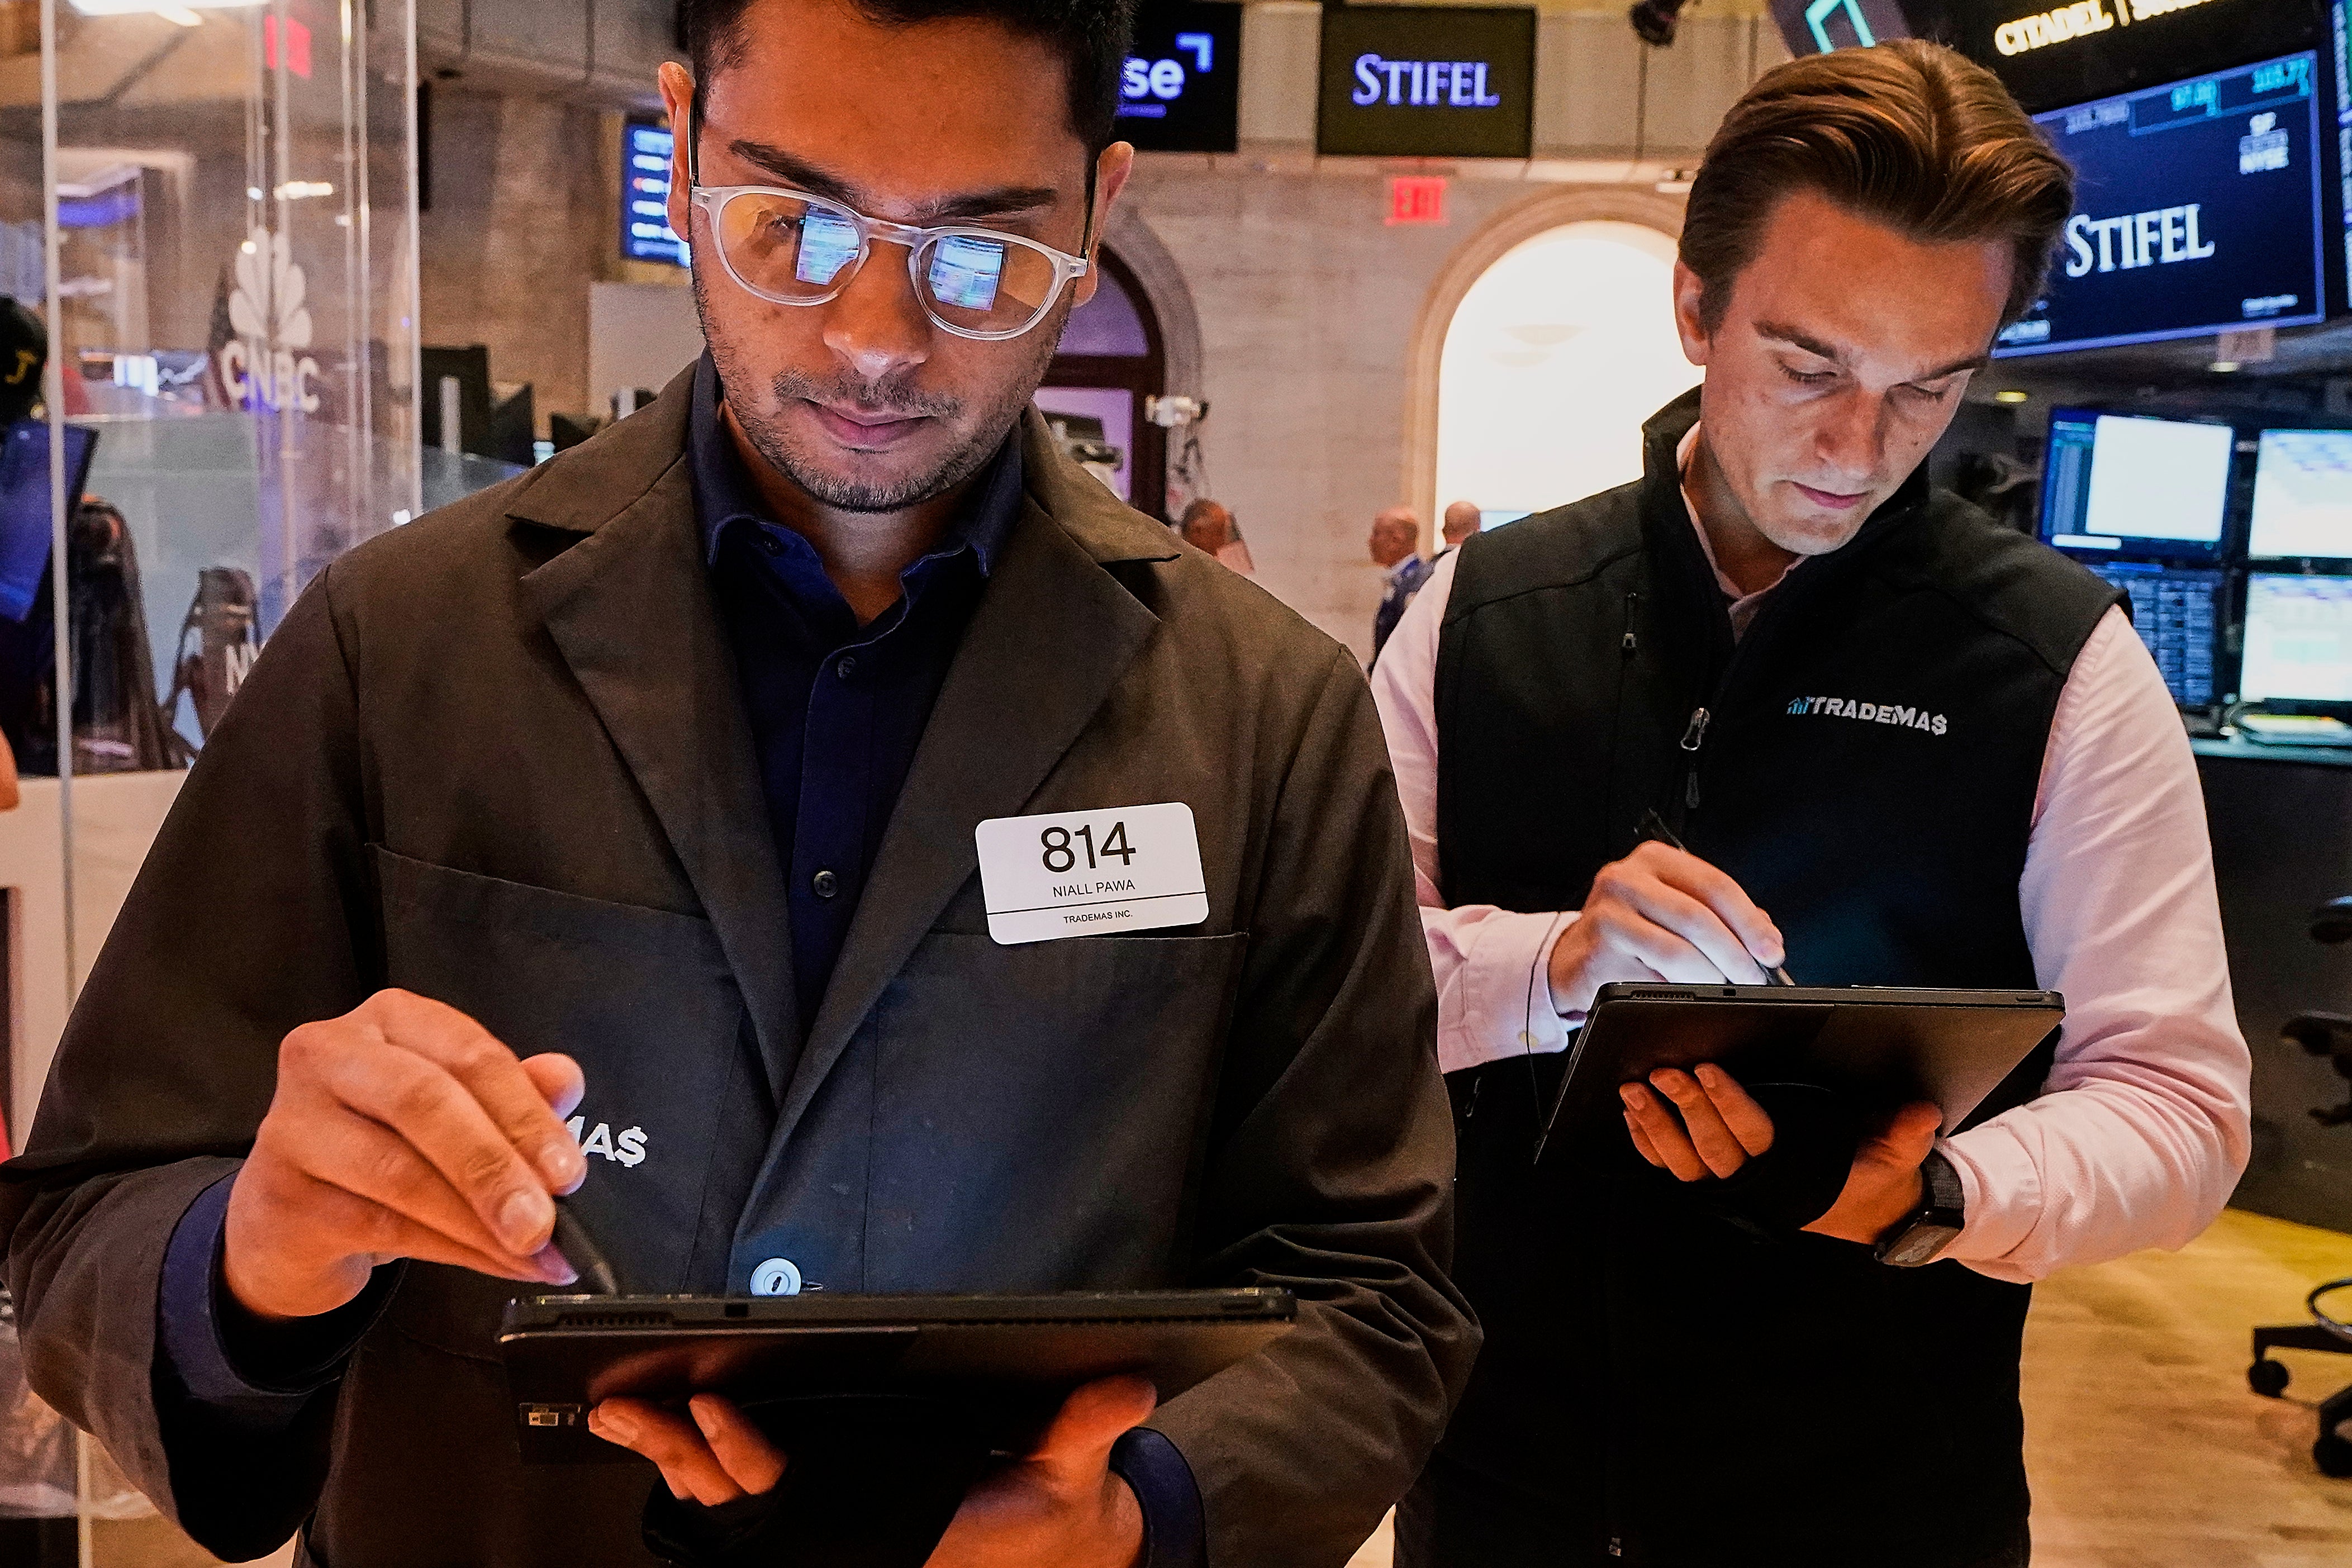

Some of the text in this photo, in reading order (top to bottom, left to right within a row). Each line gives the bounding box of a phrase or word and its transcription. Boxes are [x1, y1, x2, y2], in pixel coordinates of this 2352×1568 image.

[1995, 0, 2114, 55] CITADEL
[1353, 53, 1500, 106] STIFEL
[2066, 204, 2215, 278] STIFEL
[1040, 821, 1137, 873] 814
[1053, 879, 1135, 897] NIALL PAWA
[1063, 910, 1133, 924] TRADEMAS INC.
